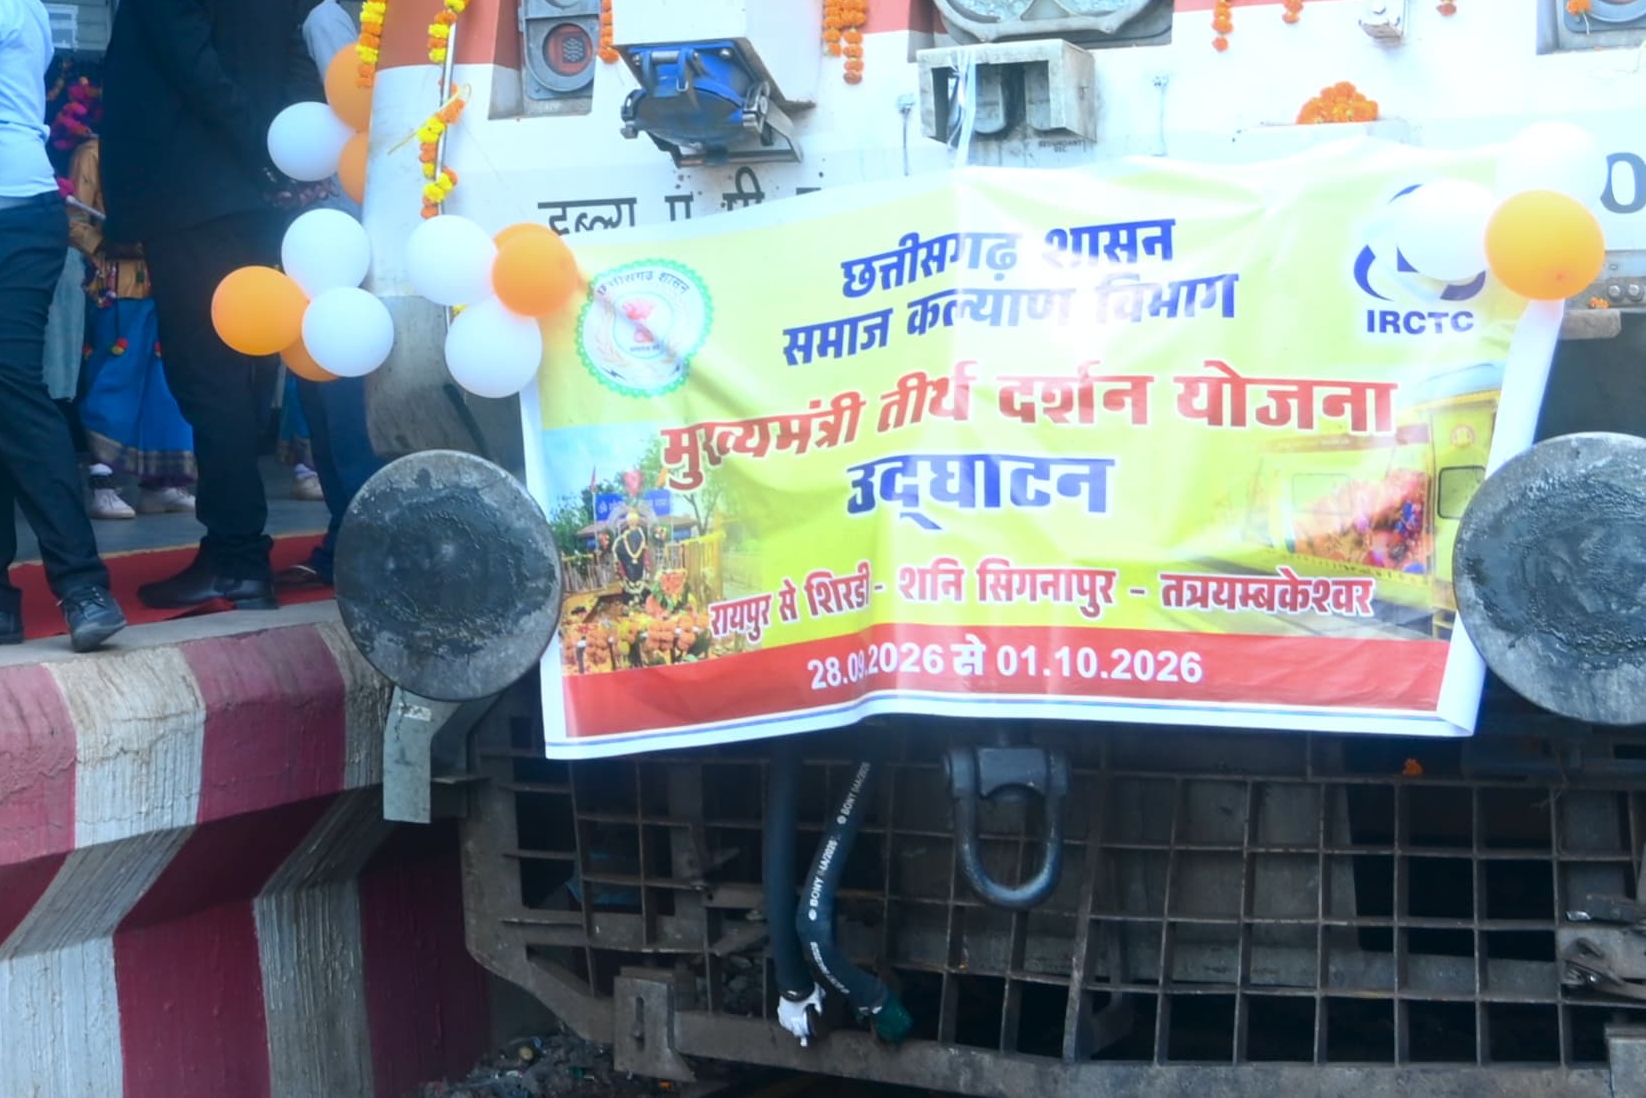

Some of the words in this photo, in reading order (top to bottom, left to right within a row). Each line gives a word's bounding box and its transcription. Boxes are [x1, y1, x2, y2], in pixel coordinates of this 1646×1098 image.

[841, 232, 1024, 298] छत्तीसगढ़
[1044, 219, 1176, 268] शासन
[782, 308, 894, 367] समाज
[907, 288, 1076, 336] कल्याण
[1095, 273, 1240, 324] विभाग
[1366, 309, 1475, 335] IRCTC
[660, 391, 867, 491] मुख्यमंत्री
[876, 361, 979, 433] तीर्थ
[996, 361, 1155, 426] दर्शन
[1173, 360, 1399, 432] योजना
[709, 593, 772, 641] रायपुर
[779, 578, 798, 621] से
[899, 557, 965, 601] शनि
[976, 558, 1117, 618] सिगनापुर
[807, 643, 944, 690] 28.09.2026
[950, 633, 986, 676] से
[996, 644, 1203, 683] 01.10.2026
